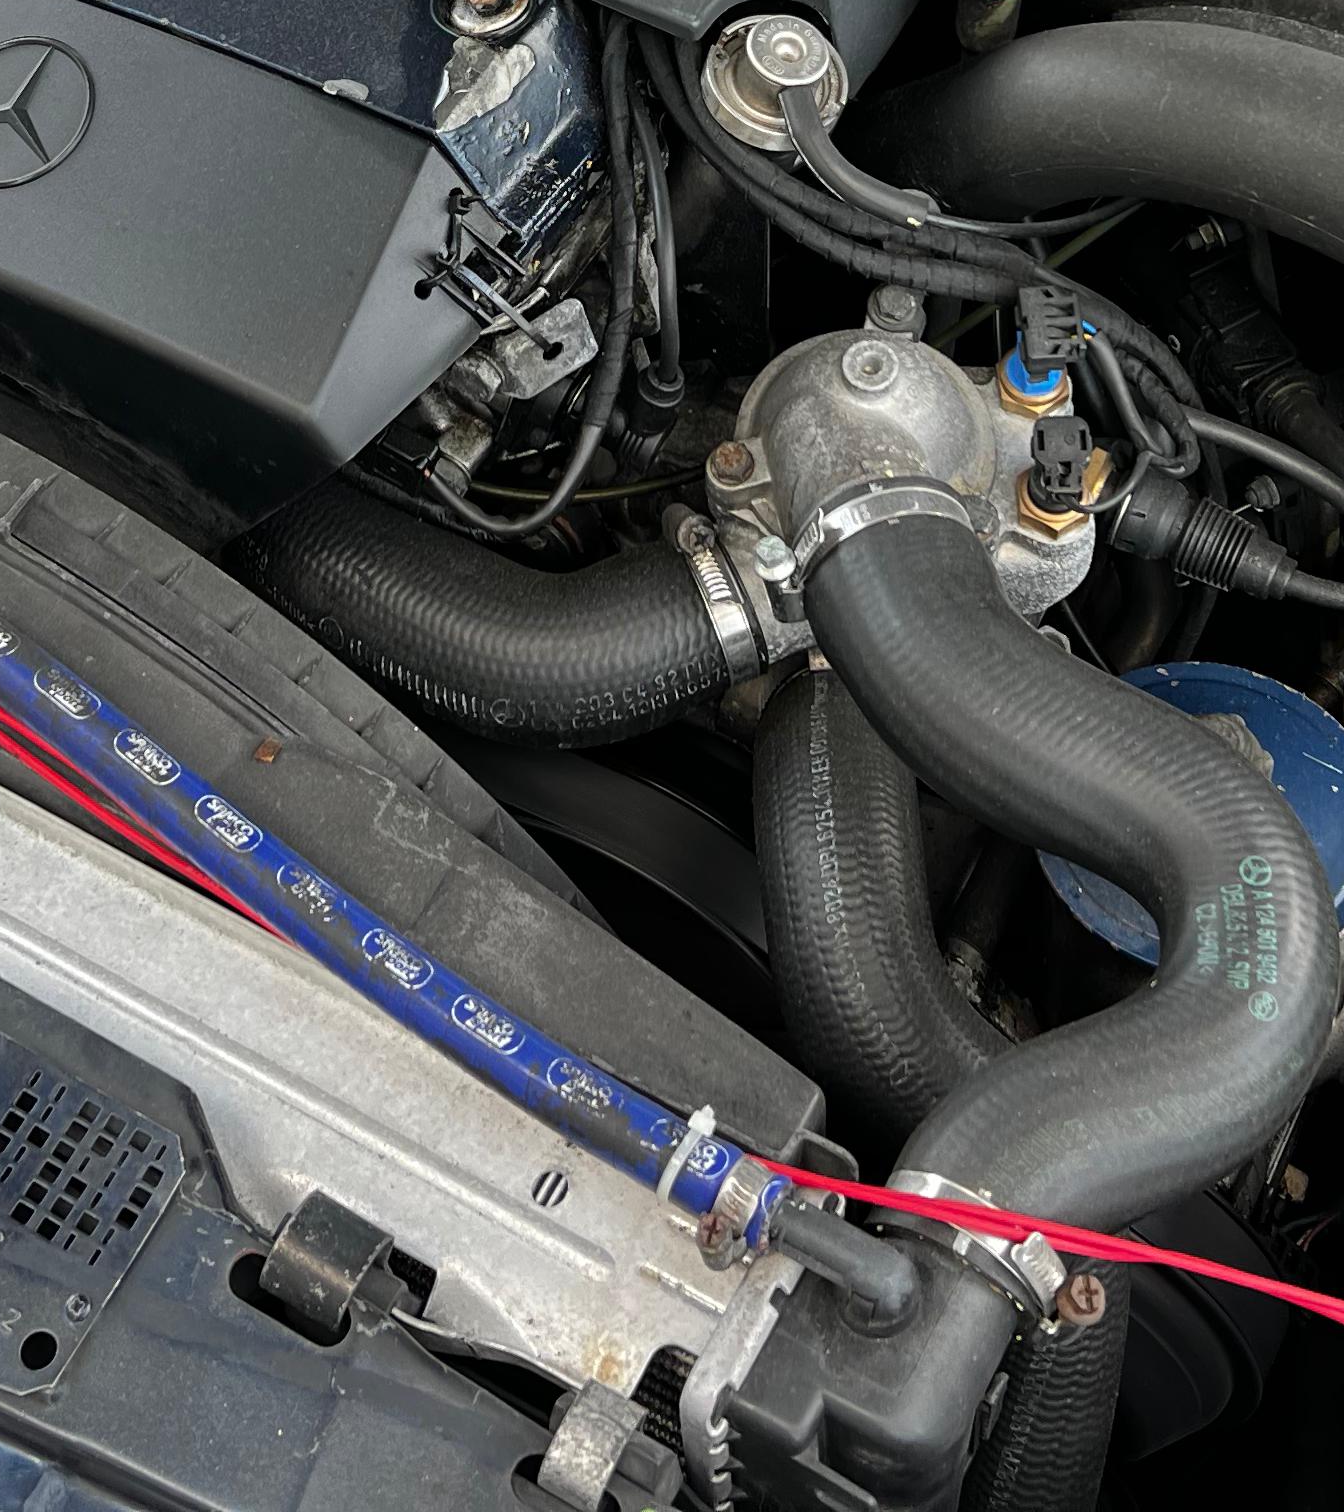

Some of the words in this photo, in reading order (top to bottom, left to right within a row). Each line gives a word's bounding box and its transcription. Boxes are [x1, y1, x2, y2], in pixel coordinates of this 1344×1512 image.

[757, 21, 785, 43] Made
[788, 20, 800, 30] in
[207, 798, 254, 836] SAMCO
[1250, 890, 1274, 901] A
[1254, 903, 1277, 927] 124
[1255, 928, 1278, 950] 501
